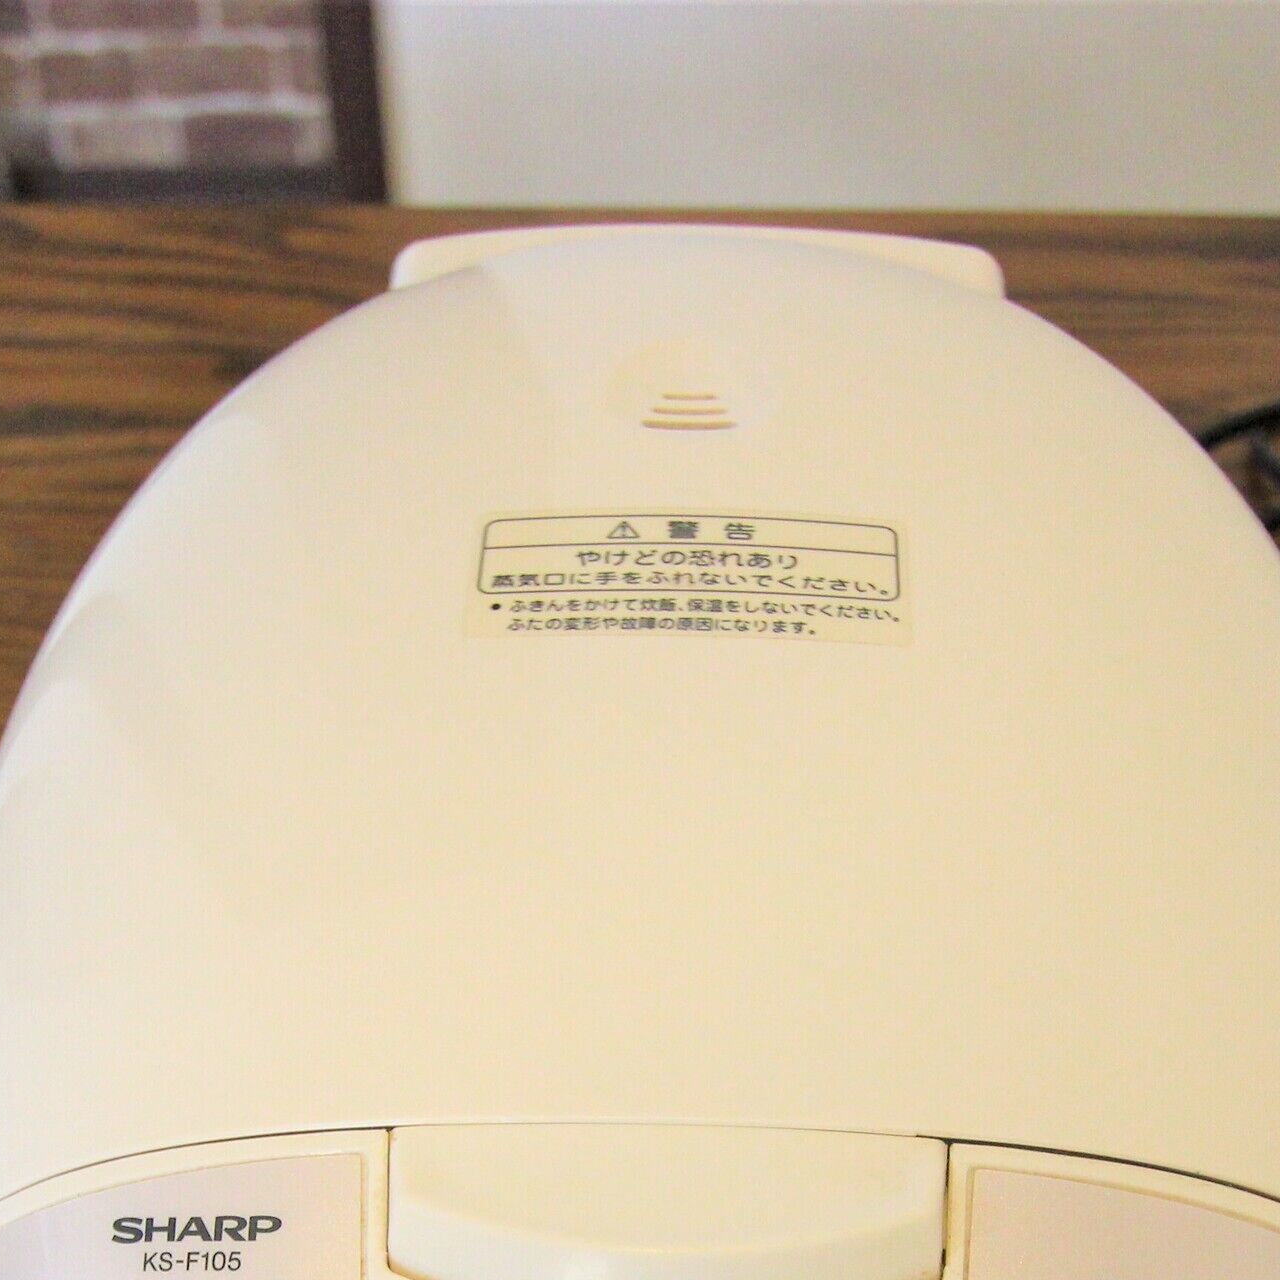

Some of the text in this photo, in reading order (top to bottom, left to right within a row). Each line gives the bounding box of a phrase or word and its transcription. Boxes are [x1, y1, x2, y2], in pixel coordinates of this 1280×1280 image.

[576, 550, 798, 569] やけどの恐れあり
[112, 1215, 282, 1243] SHARP
[143, 1251, 241, 1271] KS-F105
